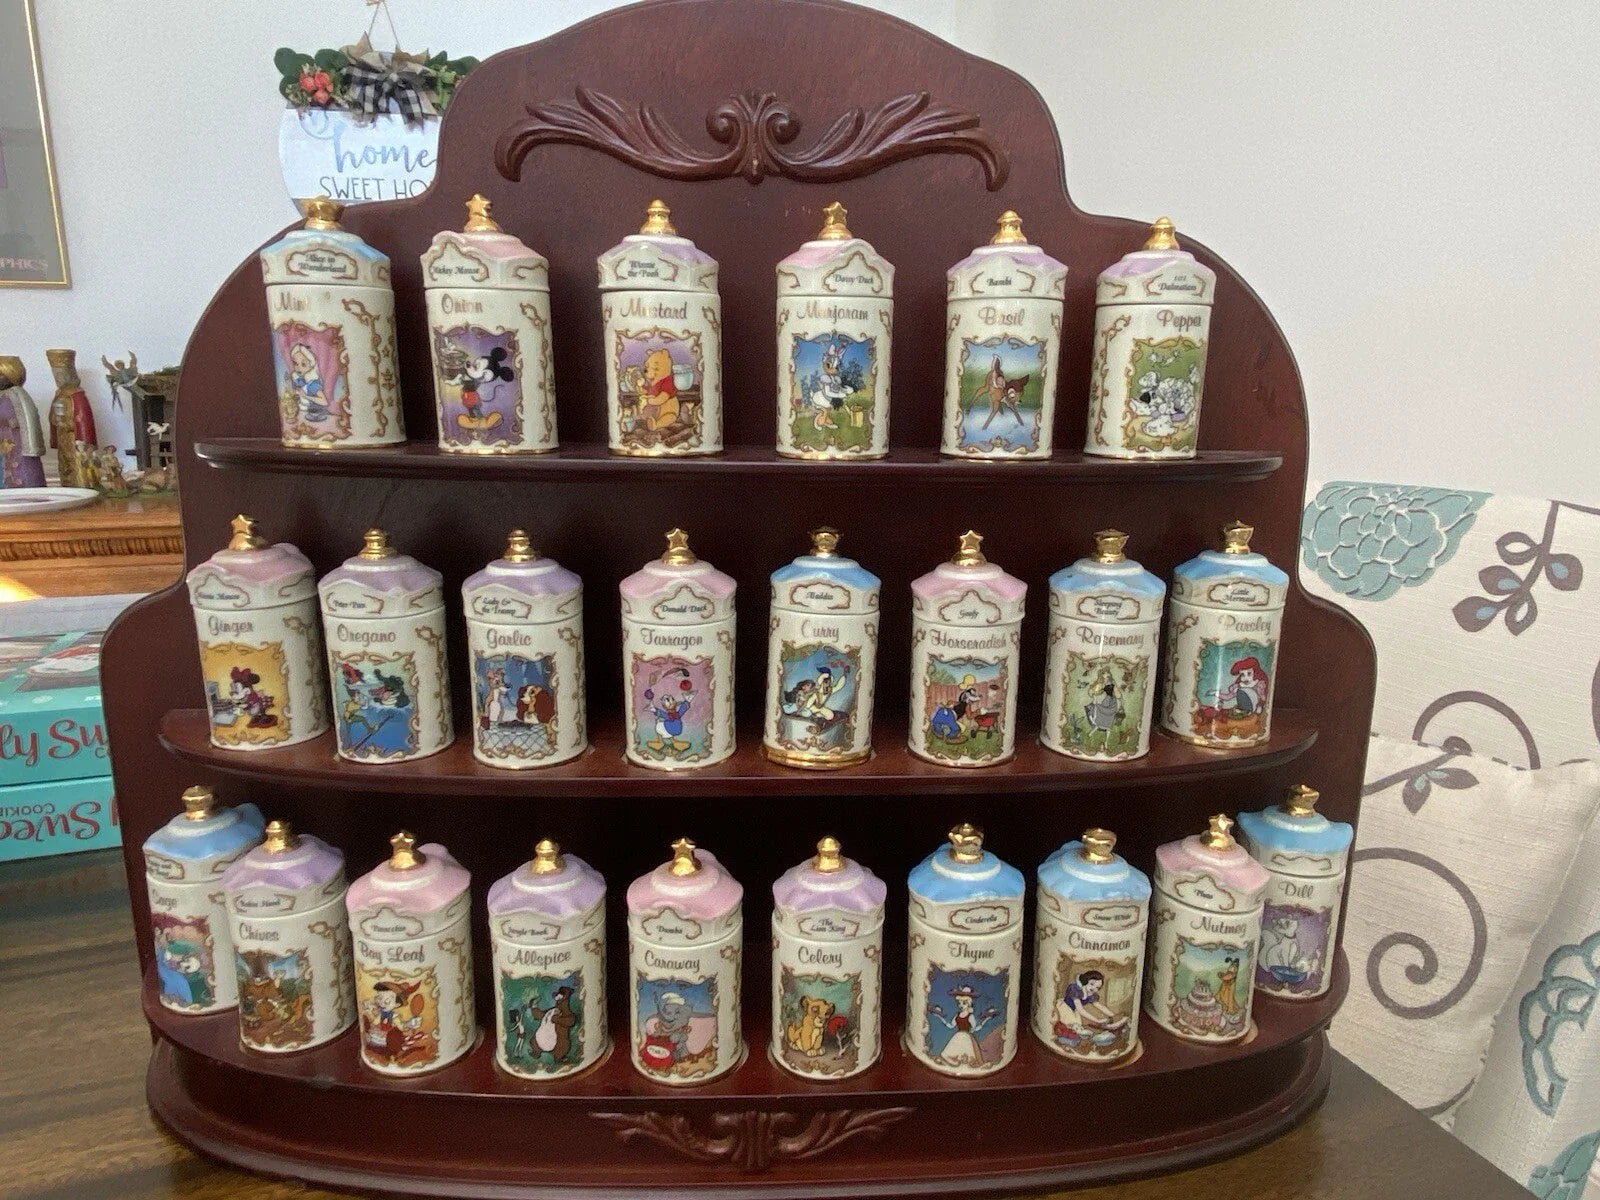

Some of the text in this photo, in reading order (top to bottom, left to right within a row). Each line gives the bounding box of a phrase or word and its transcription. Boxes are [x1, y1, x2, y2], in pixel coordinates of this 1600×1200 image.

[330, 120, 438, 173] home
[320, 176, 429, 200] SWEET HO
[0, 257, 48, 271] PHICS
[278, 291, 308, 312] Min
[441, 293, 484, 315] Onion
[621, 297, 688, 320] Mustard
[797, 300, 870, 325] Marjoram
[978, 307, 1026, 327] Basil
[1156, 309, 1202, 333] Pepper
[208, 615, 254, 638] Ginger
[337, 623, 397, 648] Oregano
[801, 619, 840, 644] Curry
[1217, 614, 1272, 637] Parsley
[486, 628, 533, 650] Garlic
[640, 628, 704, 651] Tarragon
[929, 628, 1007, 651] Horseradish
[1075, 626, 1145, 650] Rosemary
[0, 724, 39, 767] ly
[0, 801, 101, 842] Swee
[1278, 881, 1314, 899] Dill
[239, 922, 280, 942] Chives
[1190, 916, 1247, 938] Nutmeg
[357, 940, 426, 965] Bay Leaf
[948, 941, 995, 964] Thyme
[1068, 931, 1131, 952] Cinnamon
[508, 949, 572, 971] Allspice
[645, 950, 701, 974] Caraway
[798, 946, 843, 968] Celery
